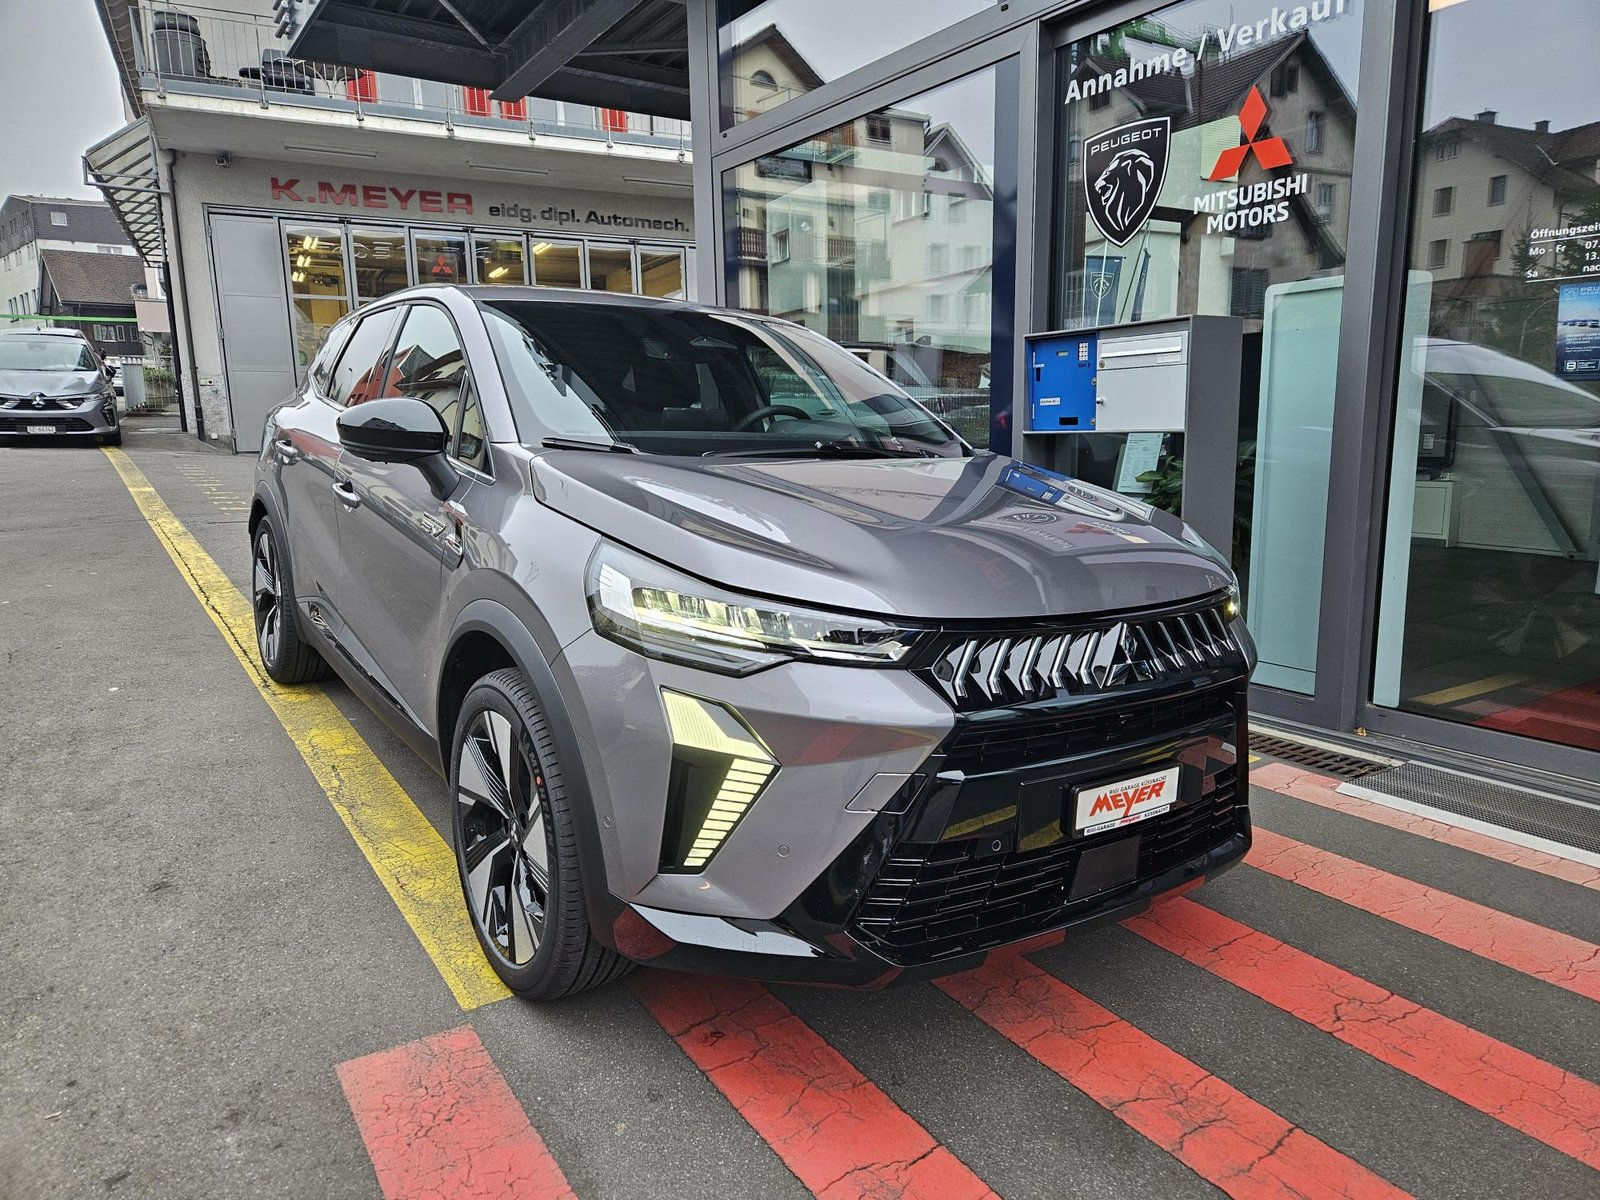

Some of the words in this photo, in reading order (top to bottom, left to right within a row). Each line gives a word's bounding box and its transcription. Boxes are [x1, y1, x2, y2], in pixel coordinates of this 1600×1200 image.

[1065, 47, 1187, 104] Annahme
[1090, 127, 1163, 156] PEUGEOT
[270, 177, 474, 215] K.MEYER
[1193, 173, 1308, 215] MITSUBISHI
[488, 203, 537, 223] eidg.
[541, 206, 581, 225] dipl.
[584, 210, 690, 233] Automech.
[1206, 202, 1290, 235] MOTORS
[1530, 221, 1600, 239] Öffnungszei
[1528, 247, 1546, 256] Mo
[1555, 244, 1567, 253] Fr
[1526, 269, 1539, 279] Sa
[1088, 781, 1167, 818] MEYER
[1120, 782, 1140, 792] GARAGE
